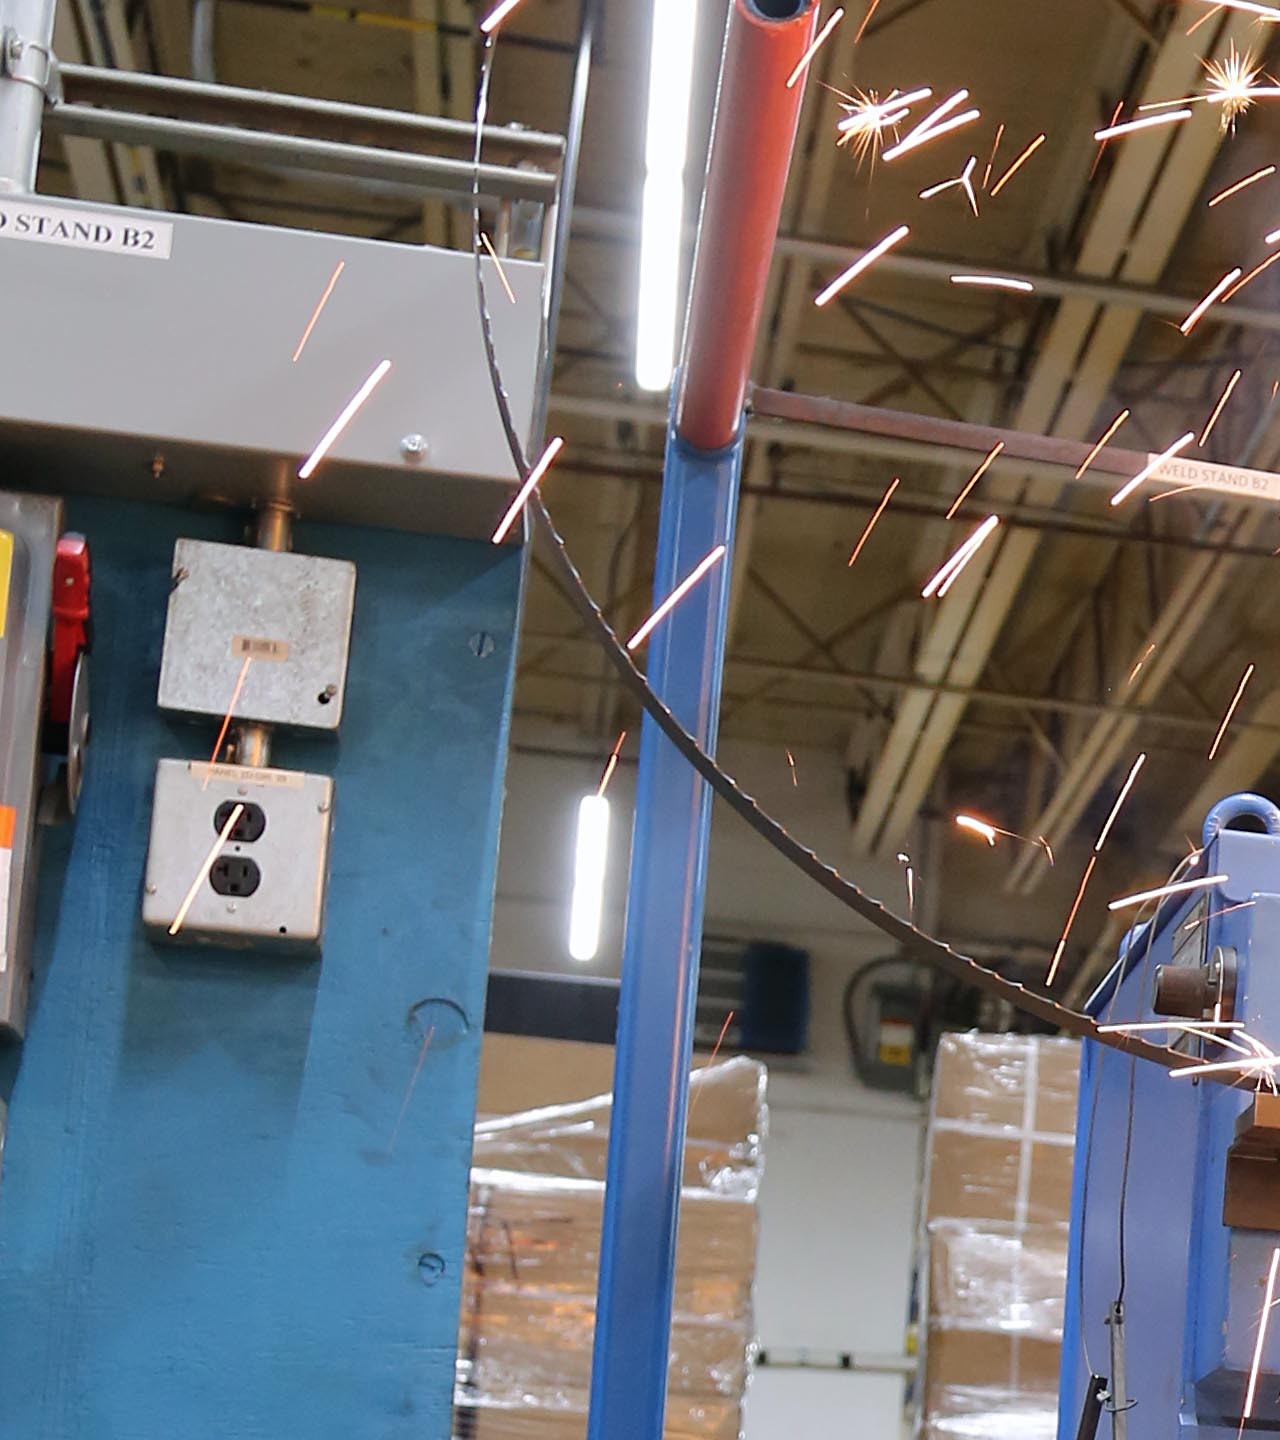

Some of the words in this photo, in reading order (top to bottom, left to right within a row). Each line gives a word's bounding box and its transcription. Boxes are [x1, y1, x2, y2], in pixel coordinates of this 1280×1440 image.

[15, 213, 113, 244] STAND
[122, 227, 156, 250] B2
[1160, 464, 1198, 480] WELD
[1201, 469, 1249, 487] STAND
[1252, 478, 1270, 491] B2
